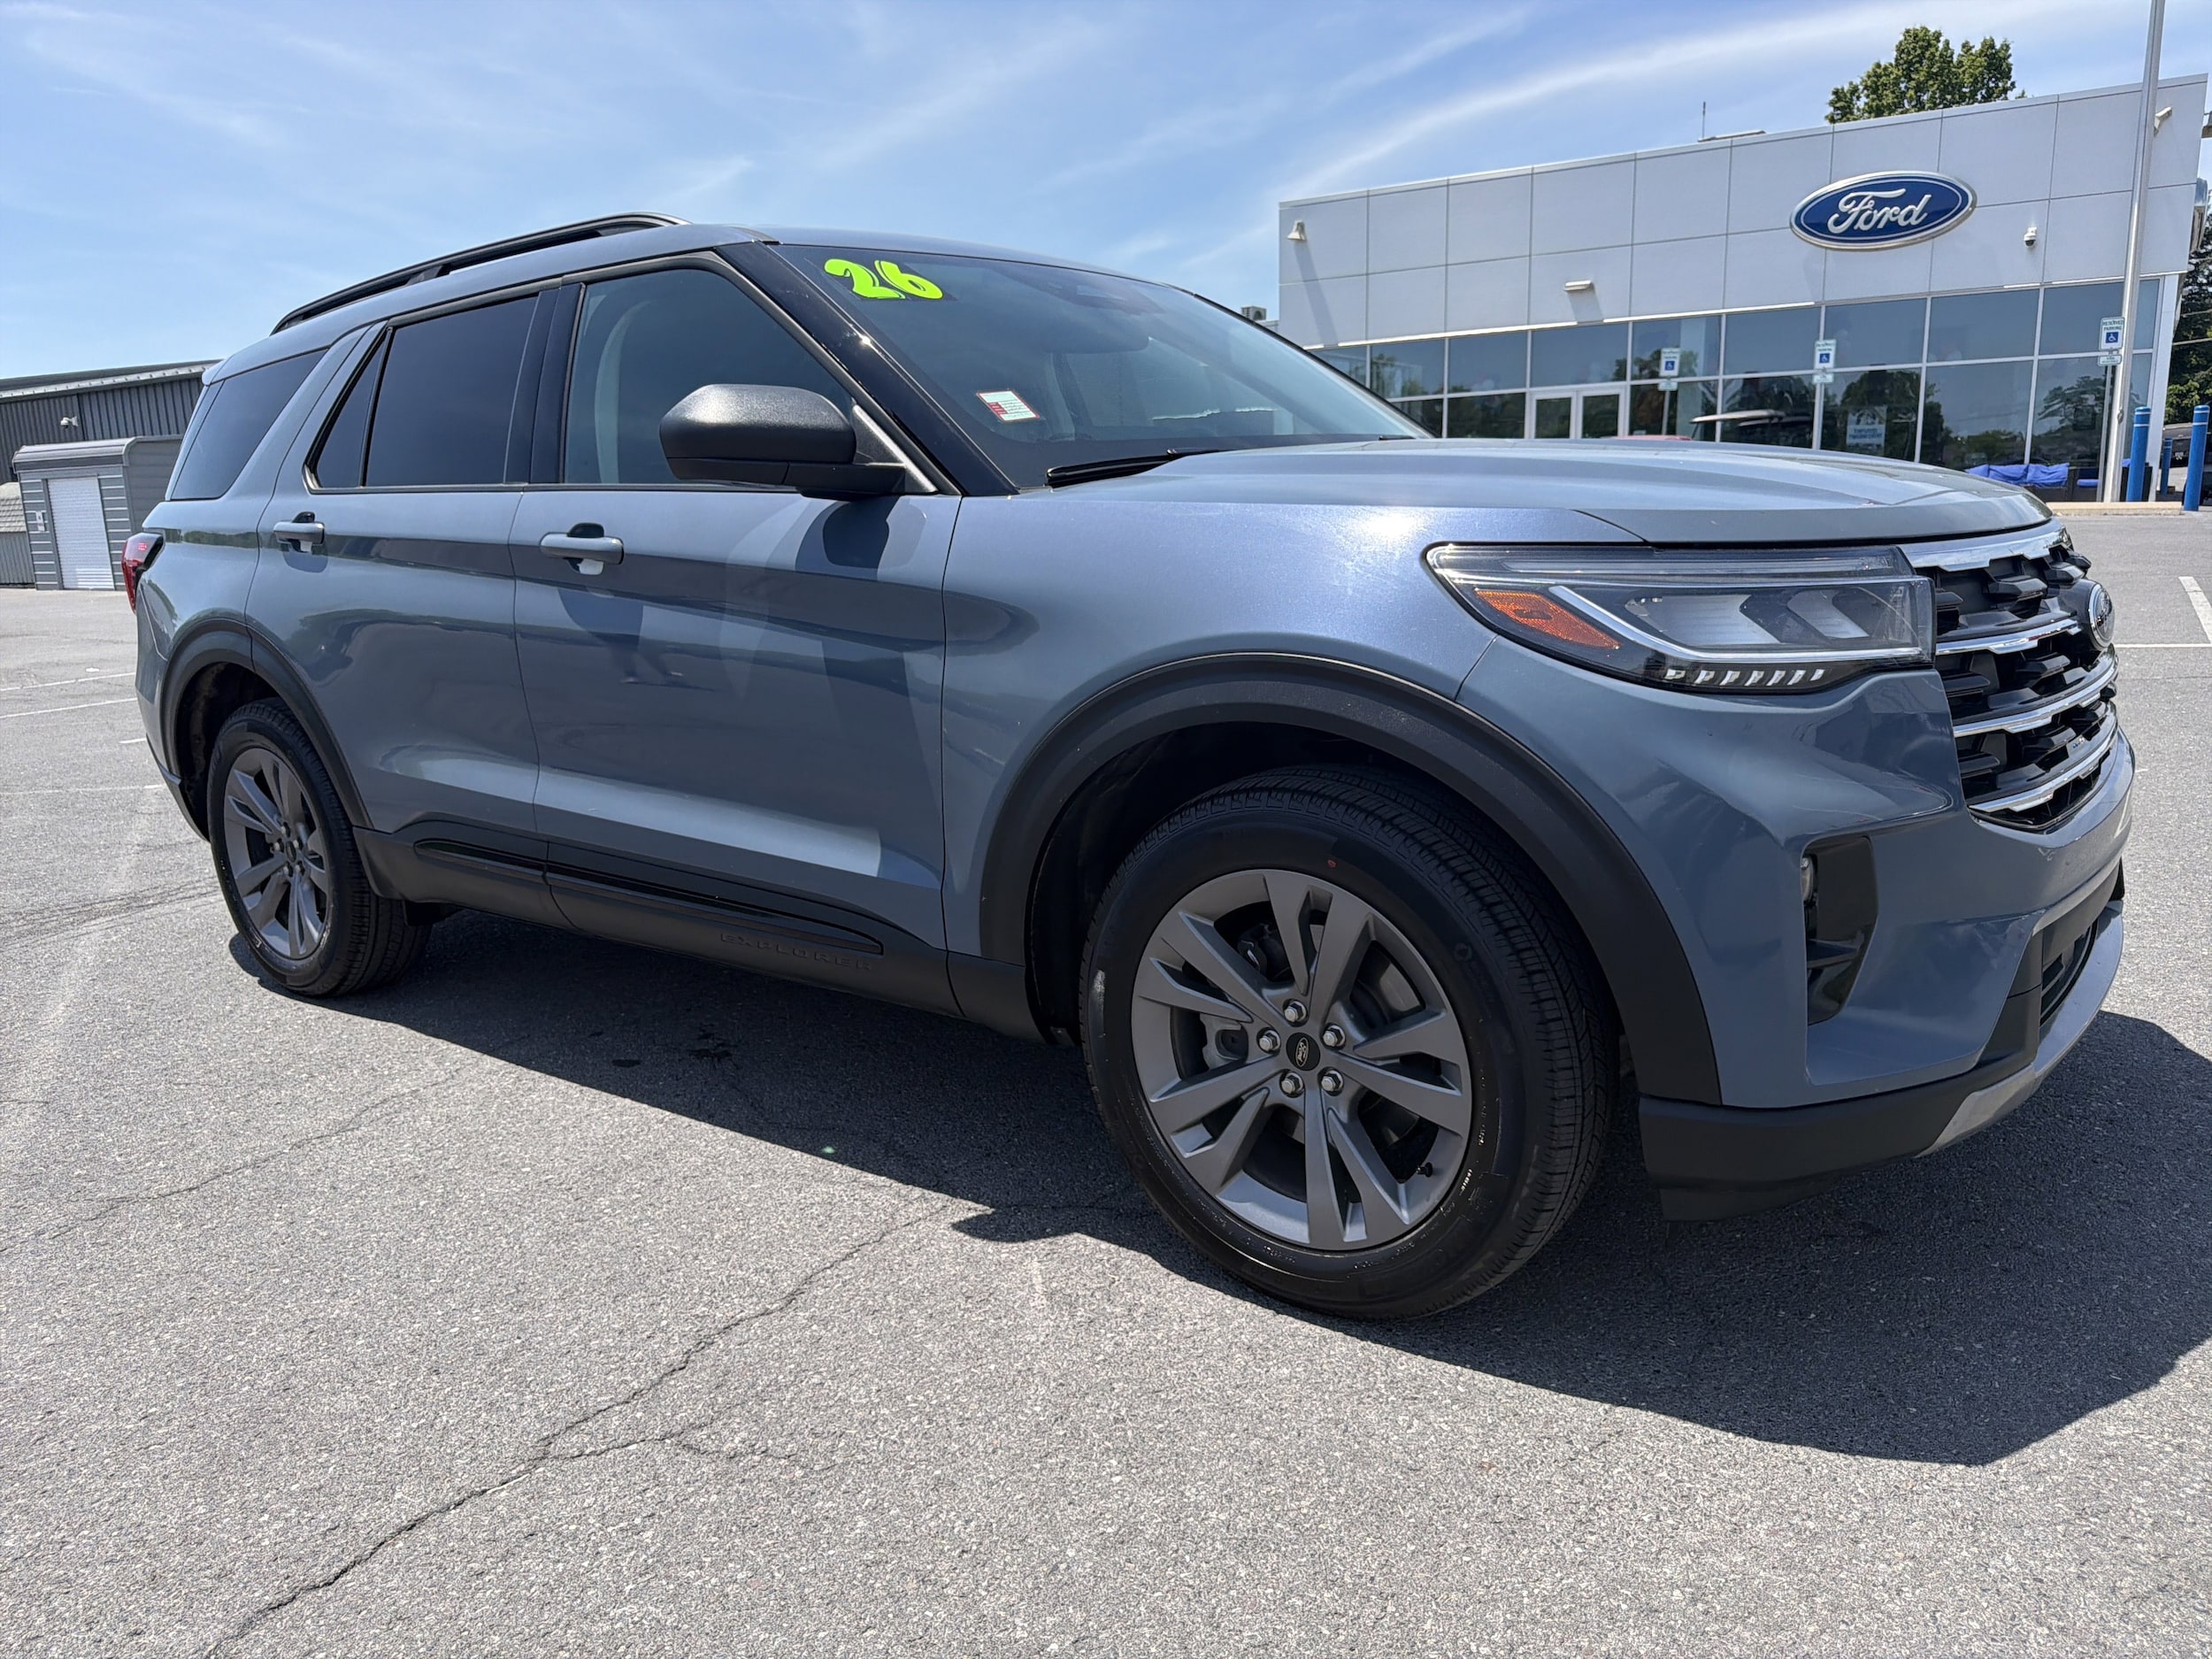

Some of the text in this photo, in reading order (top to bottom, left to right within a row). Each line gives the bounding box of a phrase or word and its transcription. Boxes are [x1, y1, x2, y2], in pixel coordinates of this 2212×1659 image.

[1827, 188, 1932, 234] Ford
[824, 258, 943, 299] 26
[720, 933, 872, 971] EXPLORER
